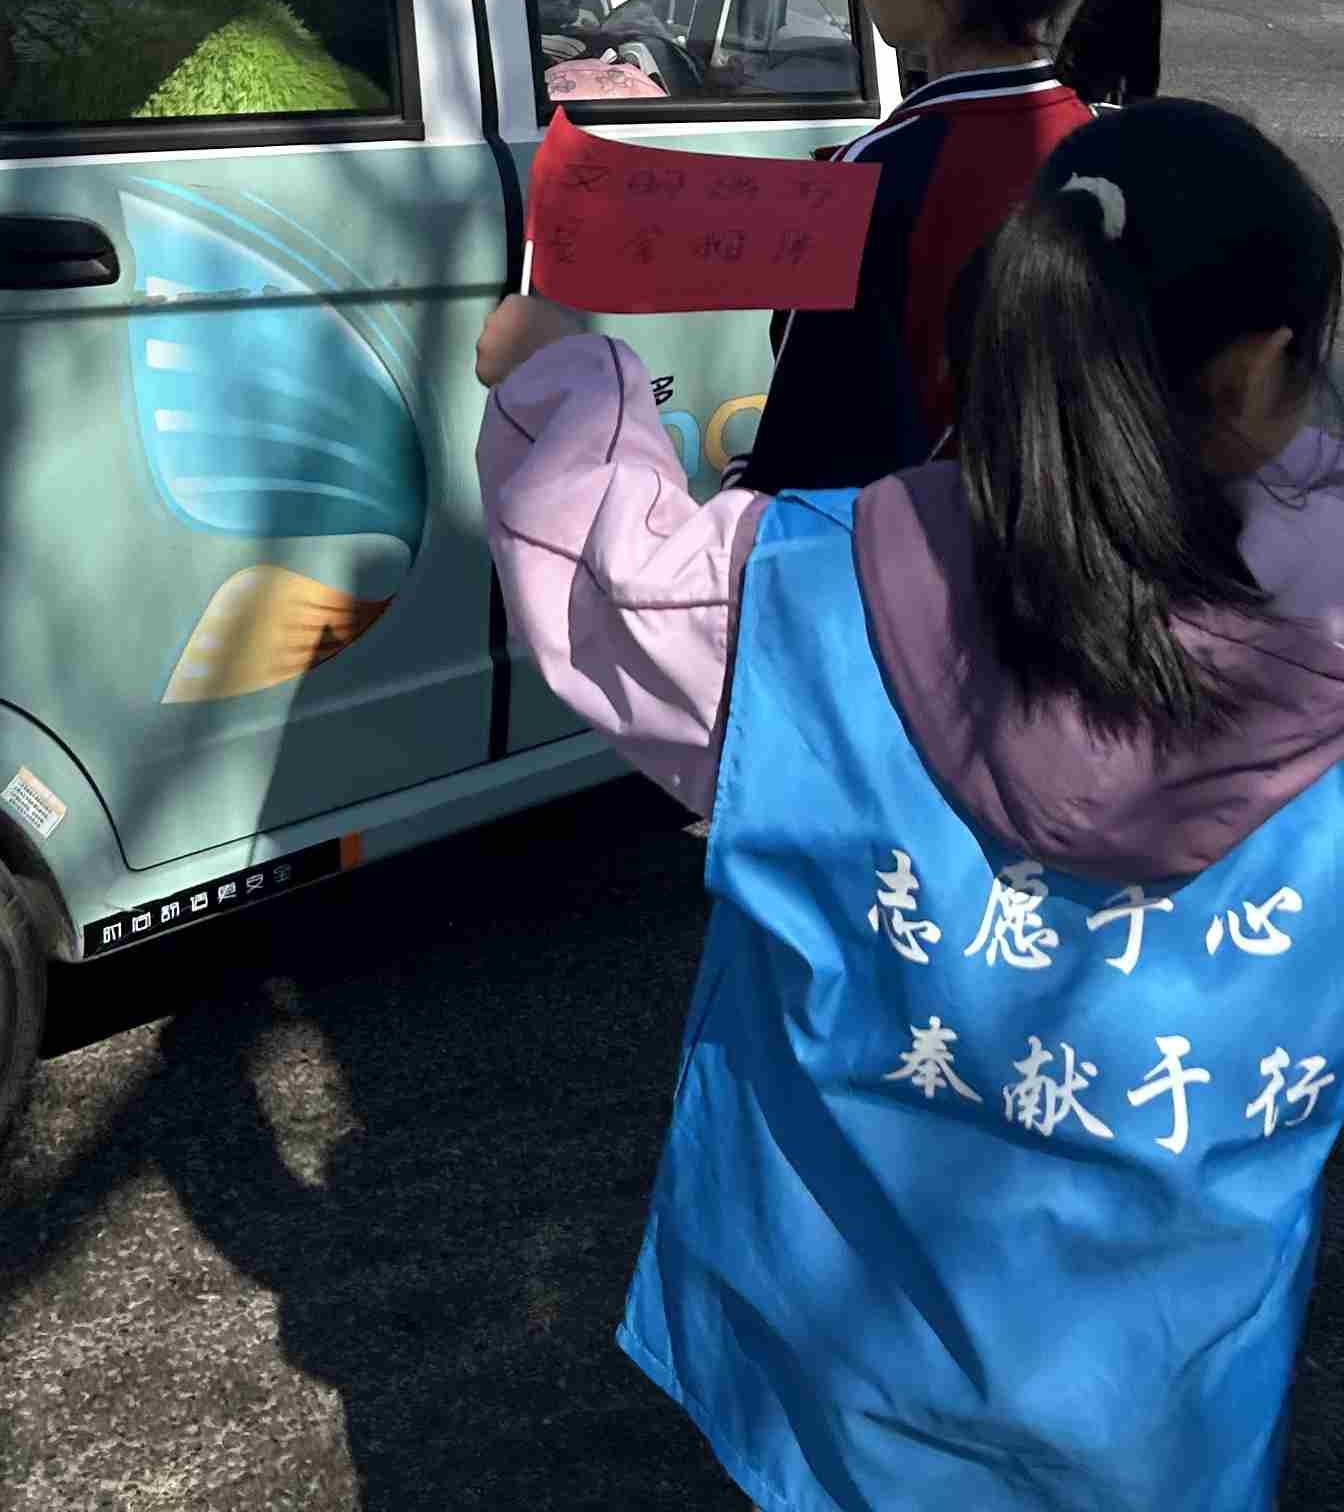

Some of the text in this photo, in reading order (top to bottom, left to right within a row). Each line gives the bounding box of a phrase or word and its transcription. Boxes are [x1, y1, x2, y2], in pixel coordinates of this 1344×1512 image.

[867, 849, 1304, 975] 志愿于心
[881, 1015, 1336, 1155] 奉献于行
